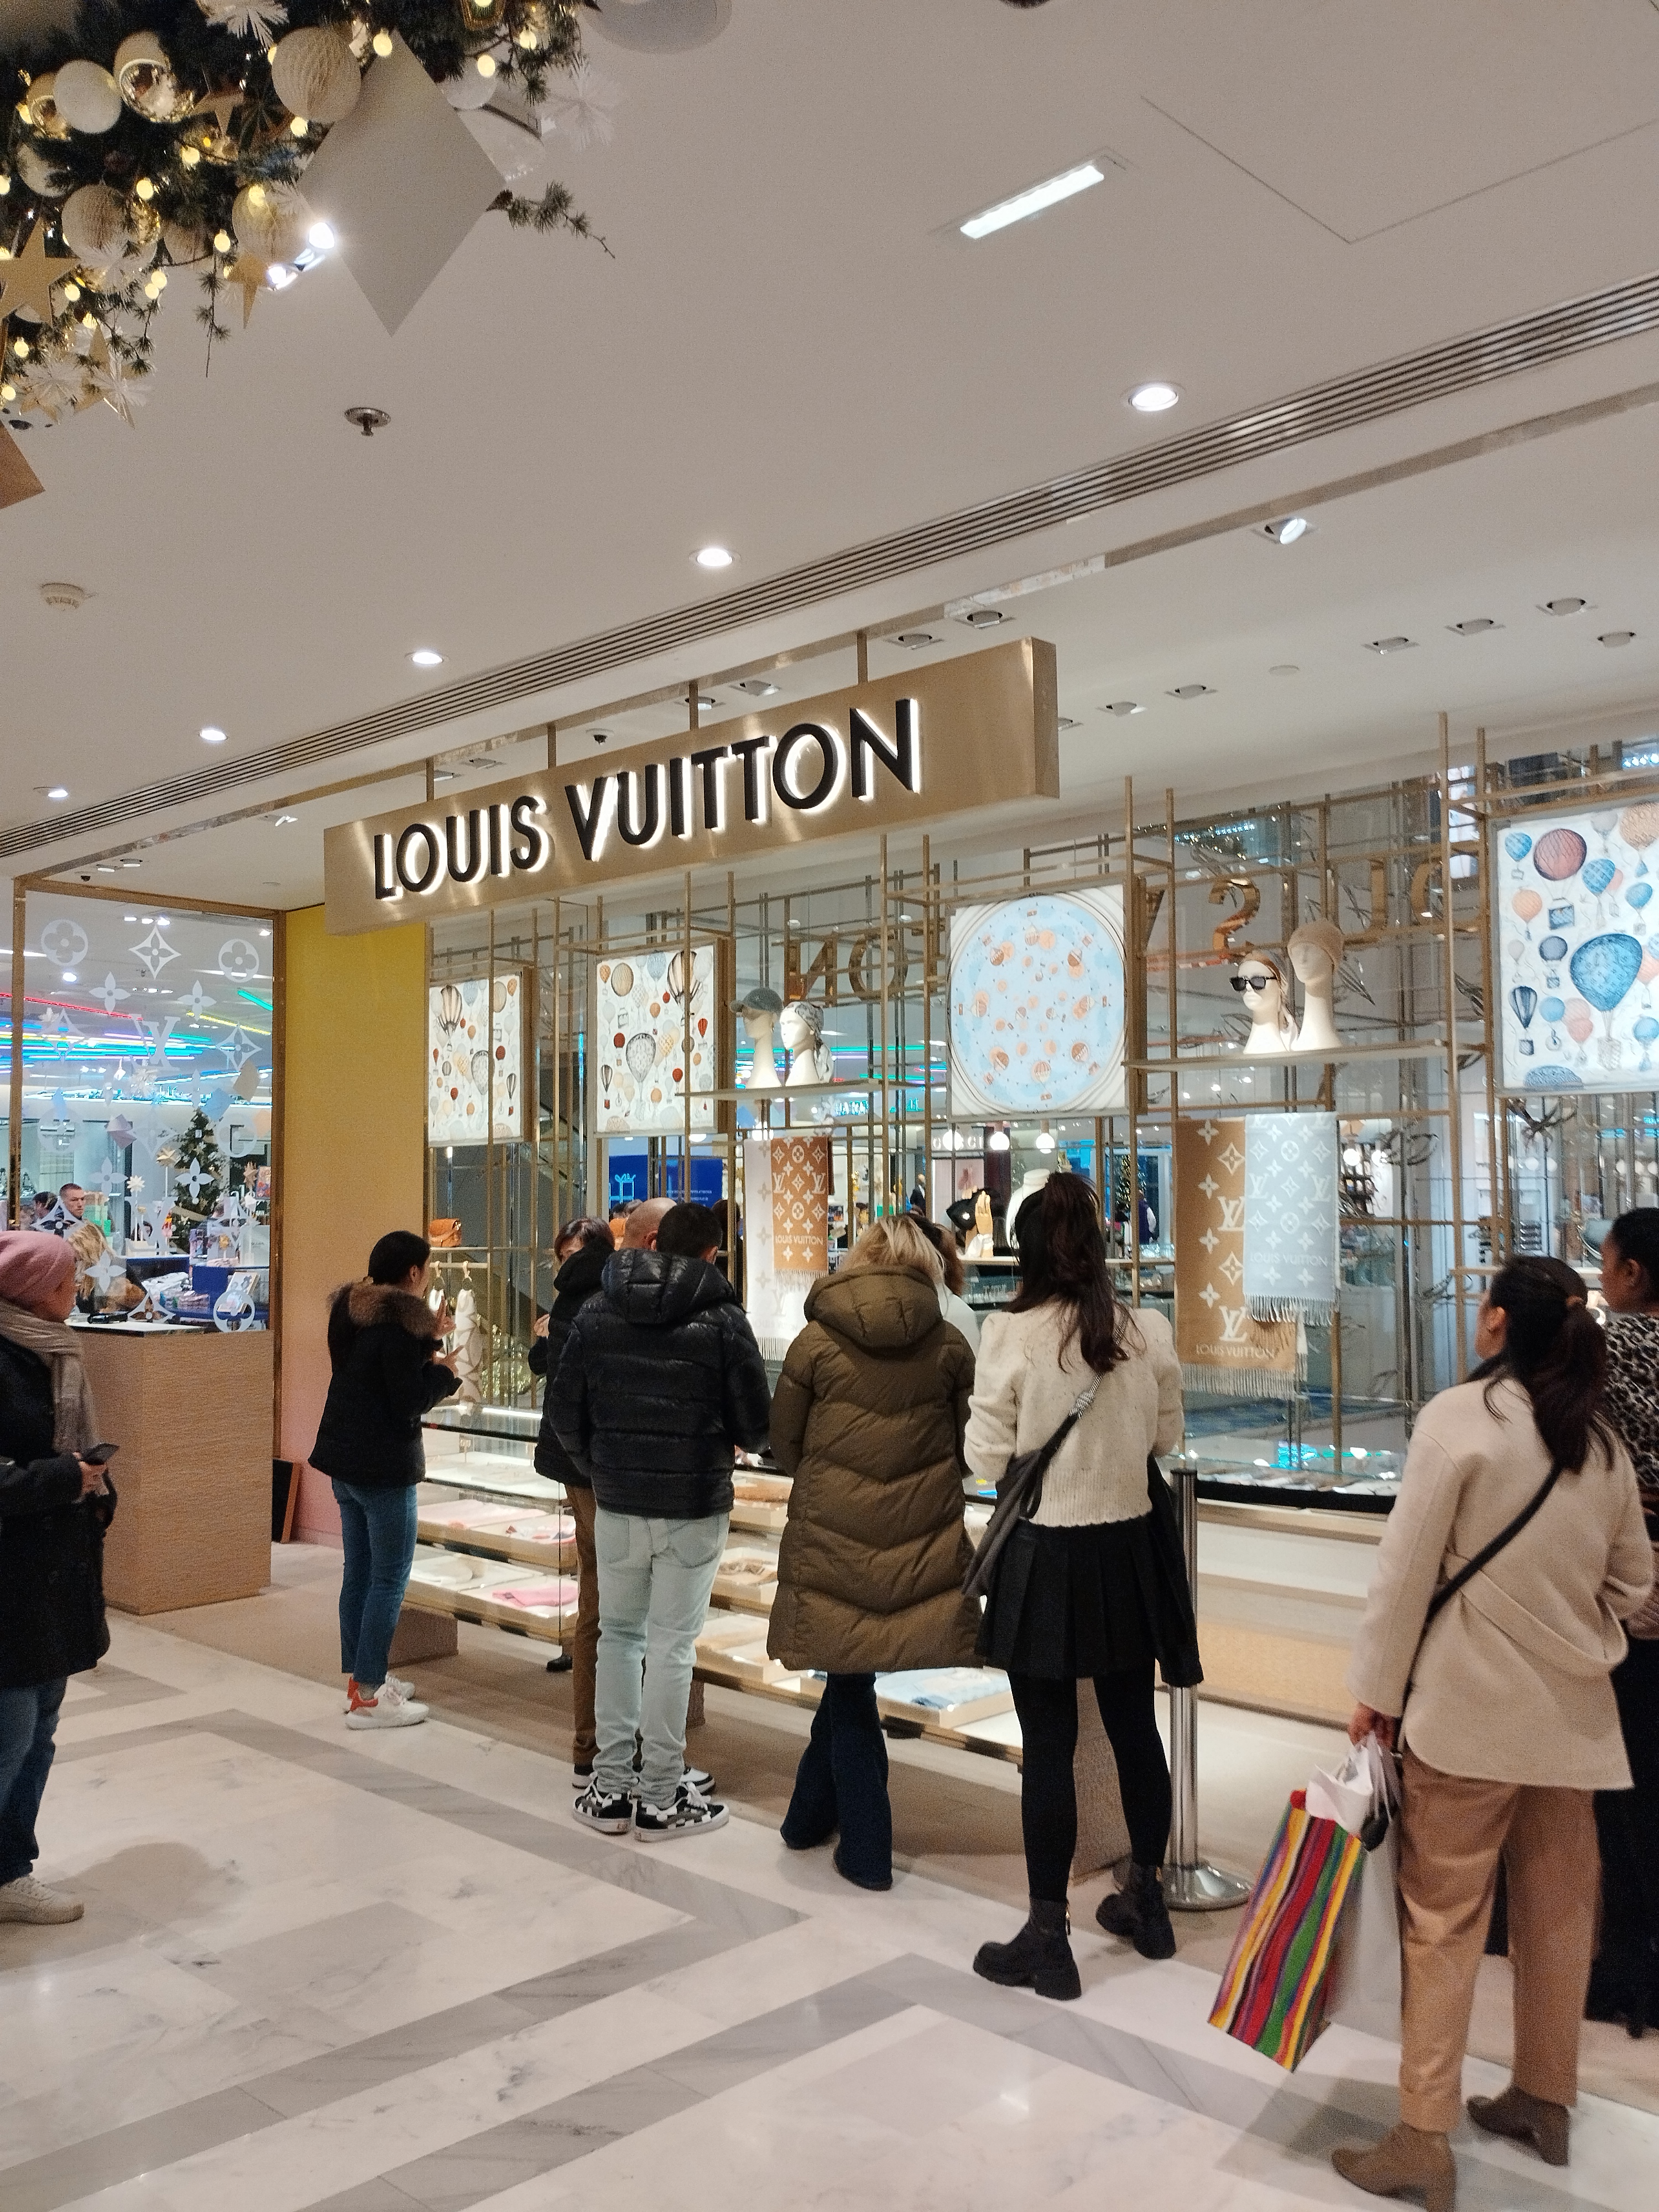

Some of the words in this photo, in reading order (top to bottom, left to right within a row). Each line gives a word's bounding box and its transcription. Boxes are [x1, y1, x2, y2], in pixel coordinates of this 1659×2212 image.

[374, 795, 544, 901] LOUIS
[564, 698, 920, 862] VUITTON
[775, 1234, 792, 1244] LOUIS
[793, 1234, 823, 1245] VUITTON
[1250, 1252, 1280, 1264] LOUIS
[1282, 1253, 1328, 1267] VUITTON
[1196, 1344, 1224, 1355] LOUIS
[1225, 1345, 1275, 1360] VUITTON
